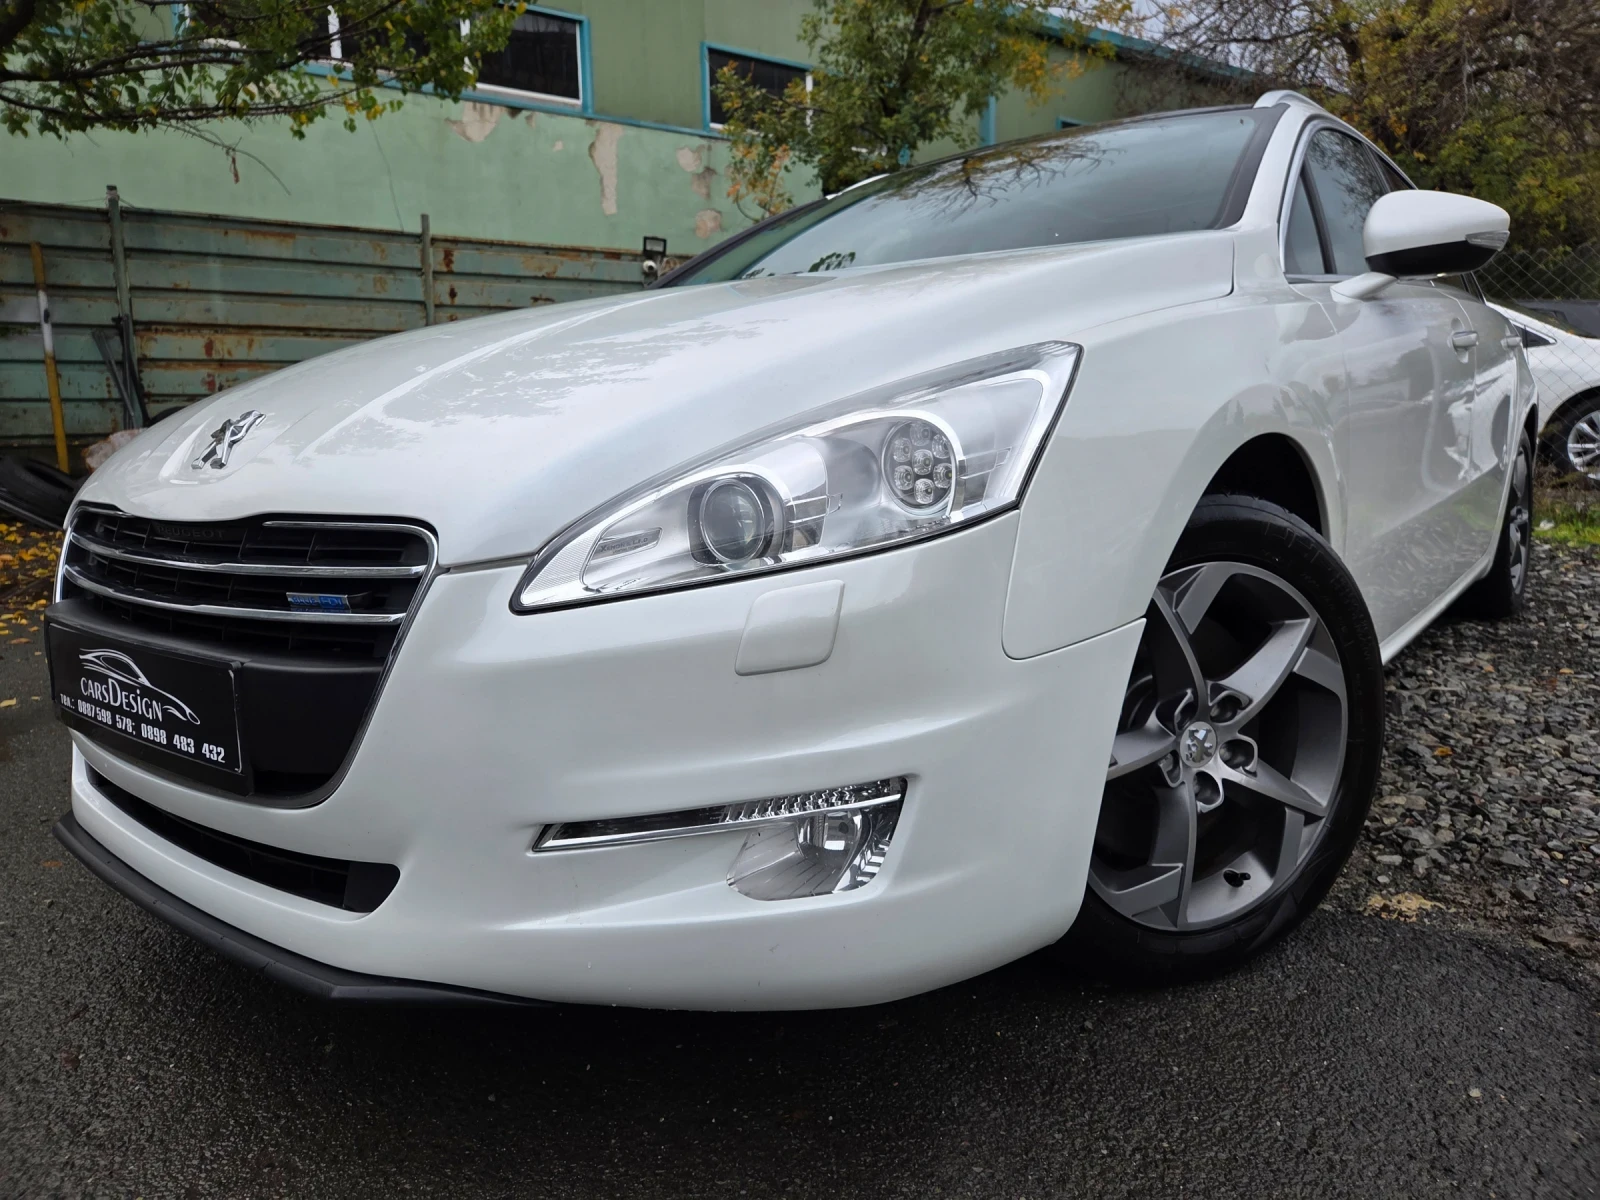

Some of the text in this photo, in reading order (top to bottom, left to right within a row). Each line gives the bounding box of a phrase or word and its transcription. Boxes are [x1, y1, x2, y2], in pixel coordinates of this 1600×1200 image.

[78, 699, 95, 718] 0887
[96, 707, 112, 725] 598
[141, 723, 167, 745] 0898
[173, 734, 195, 754] 483
[202, 743, 226, 763] 432
